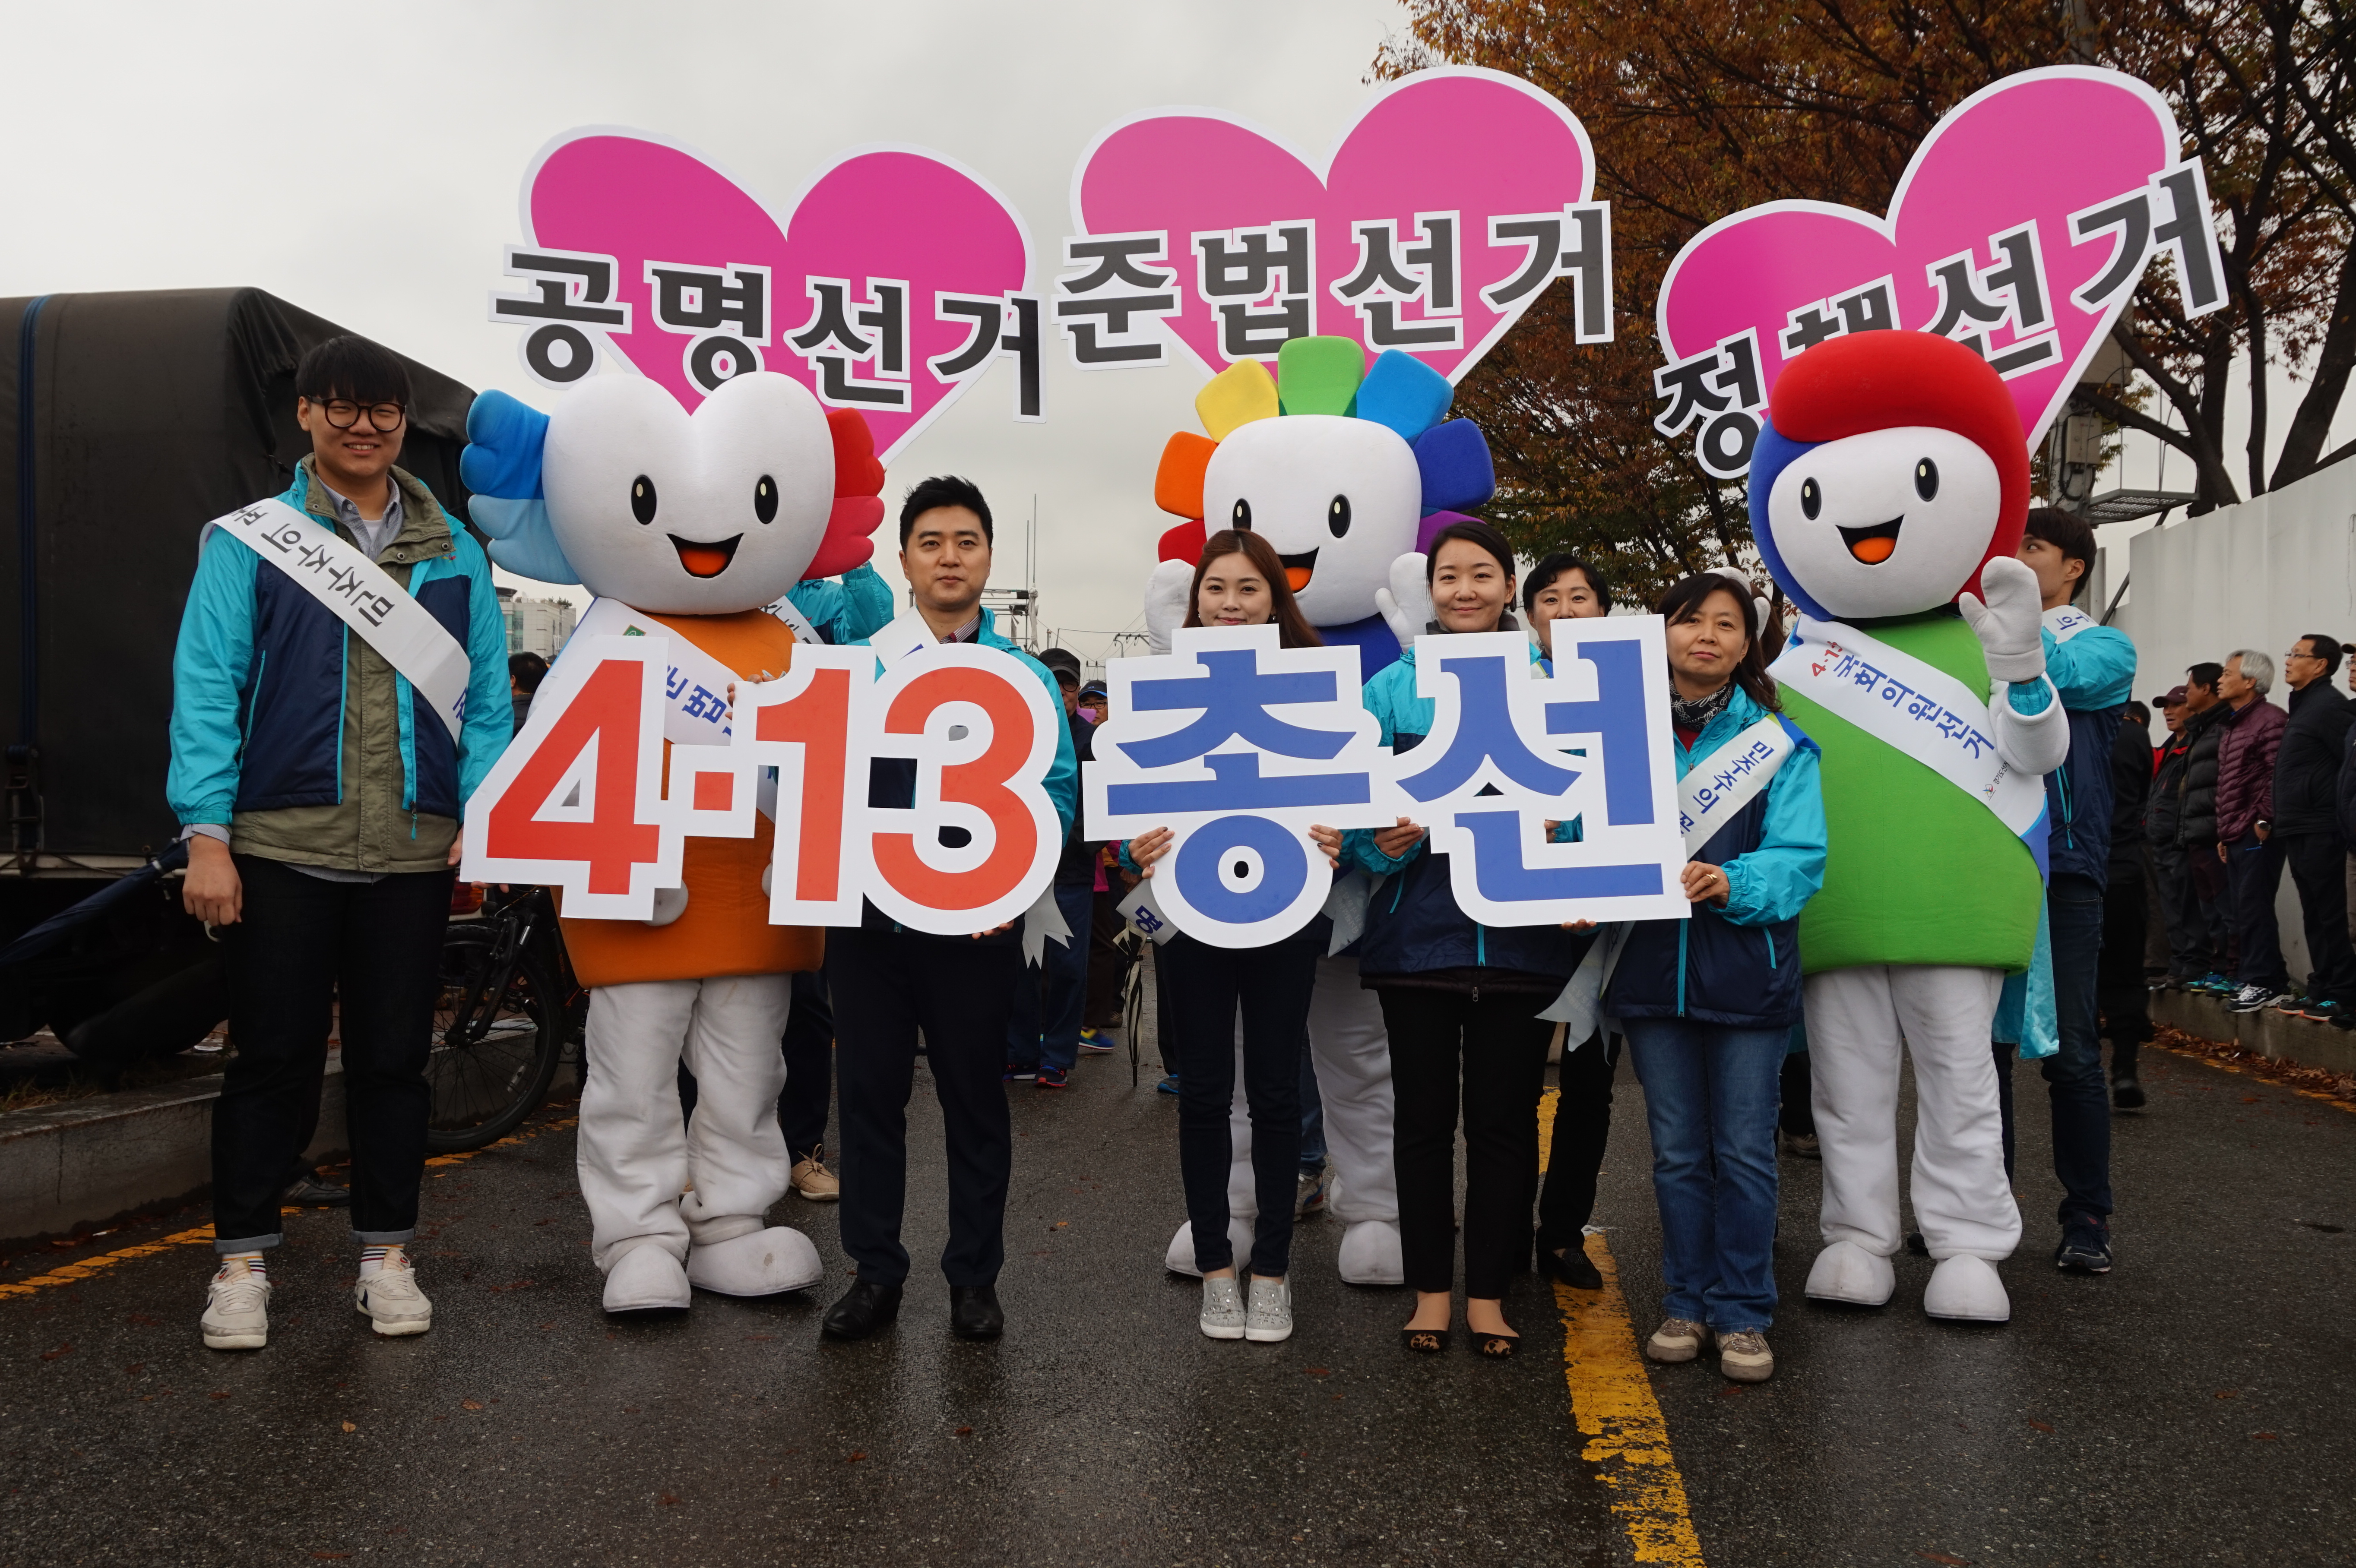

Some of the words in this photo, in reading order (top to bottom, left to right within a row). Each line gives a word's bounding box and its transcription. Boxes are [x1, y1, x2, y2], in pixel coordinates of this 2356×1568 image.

[496, 252, 1041, 417] 공명선거
[1058, 208, 1606, 363] 준법선거
[260, 522, 395, 627] 민주주의
[1833, 654, 1995, 759] 국회의원선거
[1106, 639, 1664, 924] 총선
[1692, 740, 1775, 814] 민주주의
